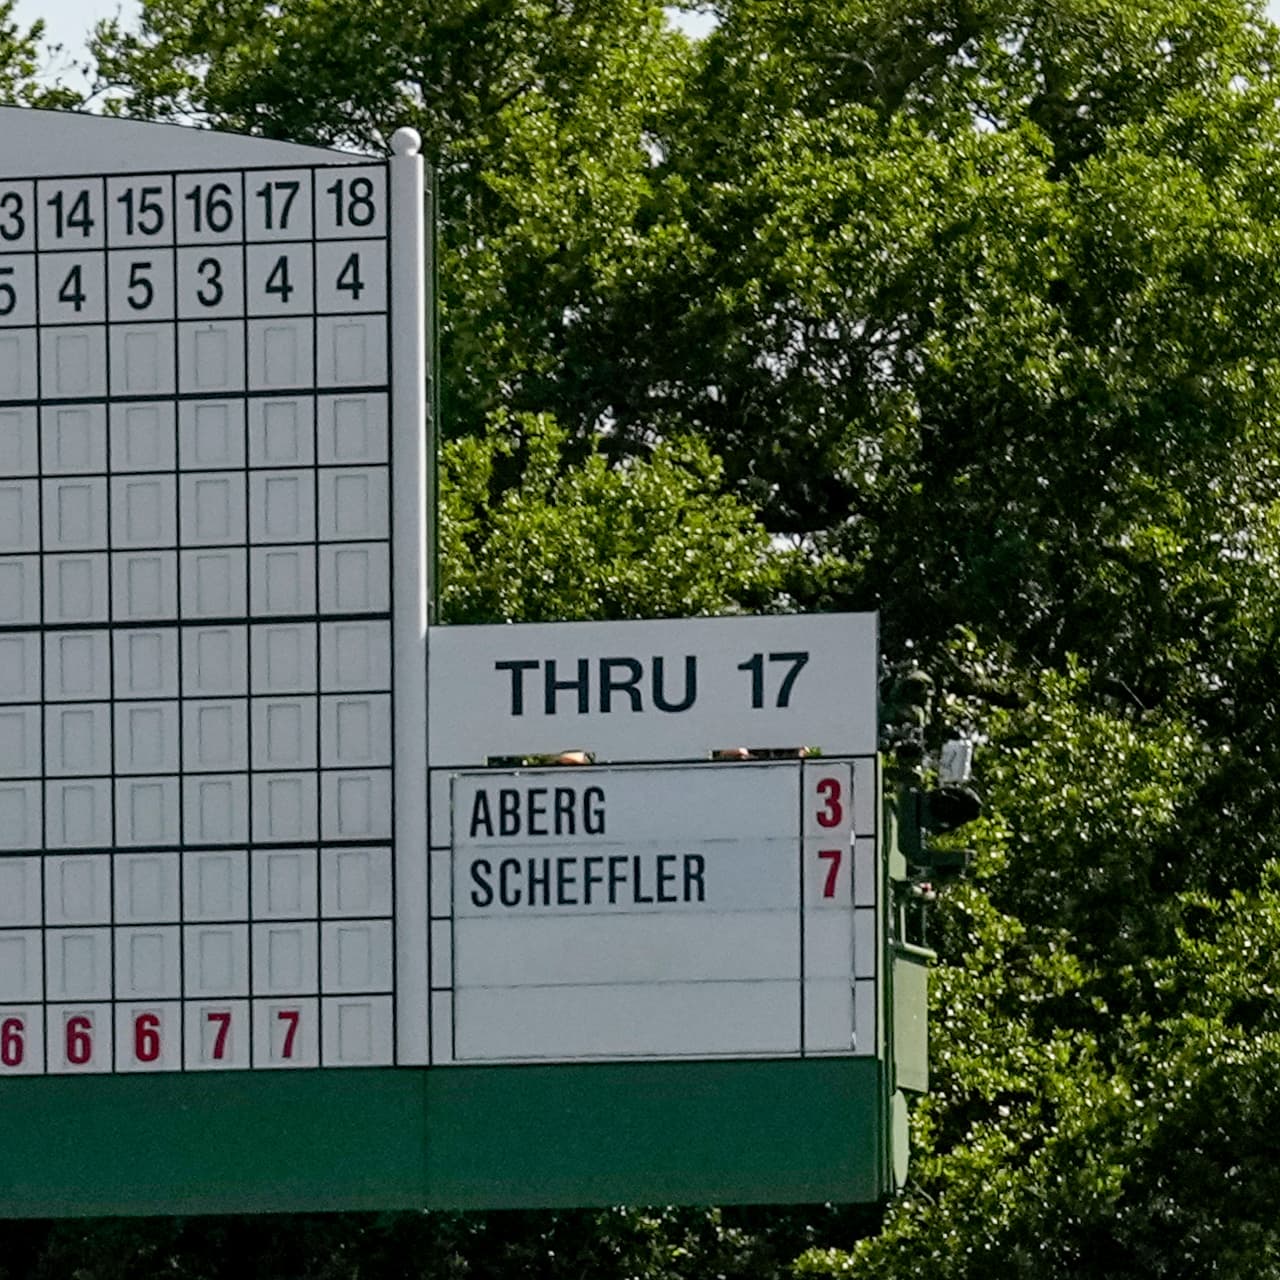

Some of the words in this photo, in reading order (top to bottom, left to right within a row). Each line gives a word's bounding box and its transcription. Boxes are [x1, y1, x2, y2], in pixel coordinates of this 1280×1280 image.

[46, 189, 95, 239] 14
[116, 186, 164, 236] 15
[184, 182, 234, 234] 16
[255, 180, 301, 230] 17
[326, 176, 376, 227] 18
[58, 264, 87, 313] 4
[127, 261, 154, 311] 5
[196, 257, 224, 308] 3
[264, 255, 294, 304] 4
[335, 252, 365, 301] 4
[494, 655, 697, 717] THRU
[737, 651, 810, 709] 17
[469, 786, 606, 838] ABERG
[815, 778, 843, 828] 3
[470, 853, 705, 908] SCHEFFLER
[817, 849, 842, 899] 7
[0, 1017, 25, 1067] 6
[65, 1015, 93, 1065] 6
[134, 1013, 160, 1063] 6
[207, 1012, 232, 1060] 7
[277, 1010, 300, 1059] 7
